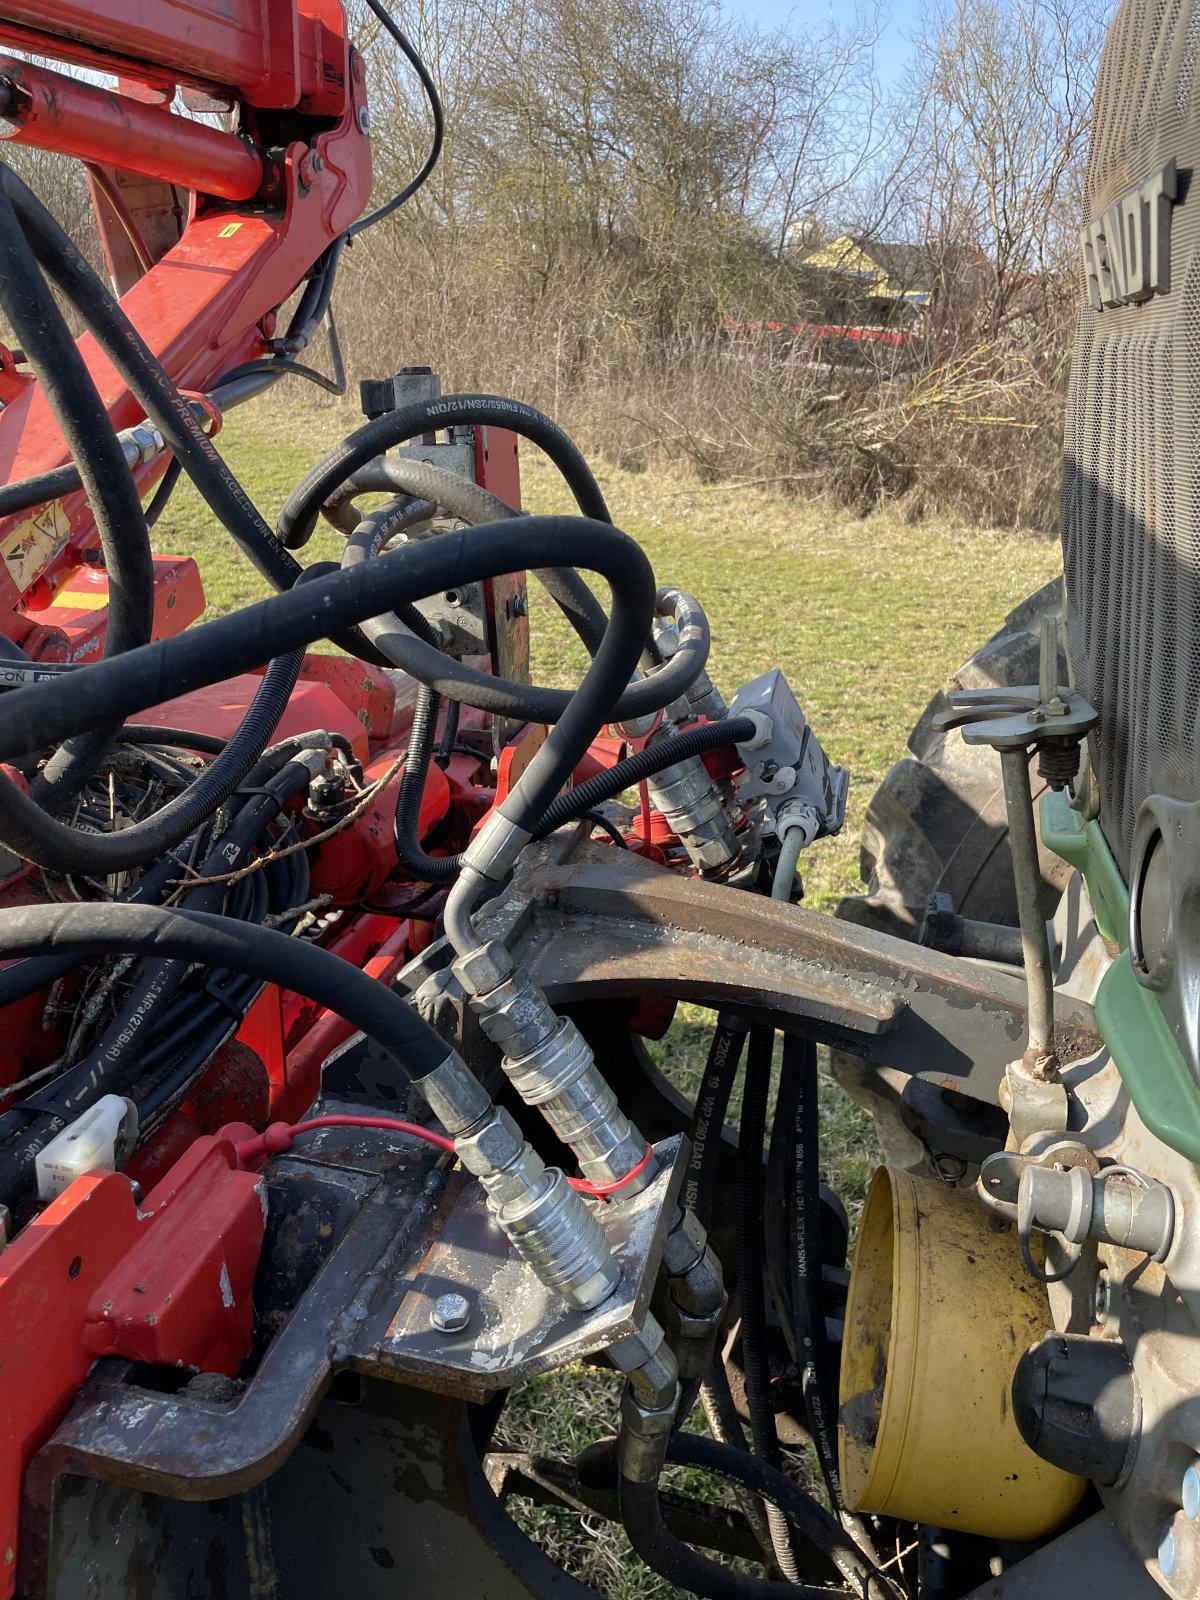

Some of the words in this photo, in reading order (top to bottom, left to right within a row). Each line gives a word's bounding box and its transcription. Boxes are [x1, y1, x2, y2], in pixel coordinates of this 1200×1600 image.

[1080, 155, 1176, 312] FENDT
[171, 399, 219, 461] PREMIUM
[220, 467, 256, 518] EXCEEDS
[253, 519, 270, 538] DIN
[268, 537, 281, 553] EN
[713, 1035, 731, 1068] 220S
[707, 1074, 721, 1089] 19
[703, 1096, 716, 1119] WP
[695, 1118, 710, 1141] 280
[690, 1139, 706, 1170] BAR
[796, 1143, 804, 1160] 856
[685, 1179, 699, 1213] MSH
[797, 1216, 807, 1277] HANSA-FLEX
[828, 1469, 841, 1494] BAR
